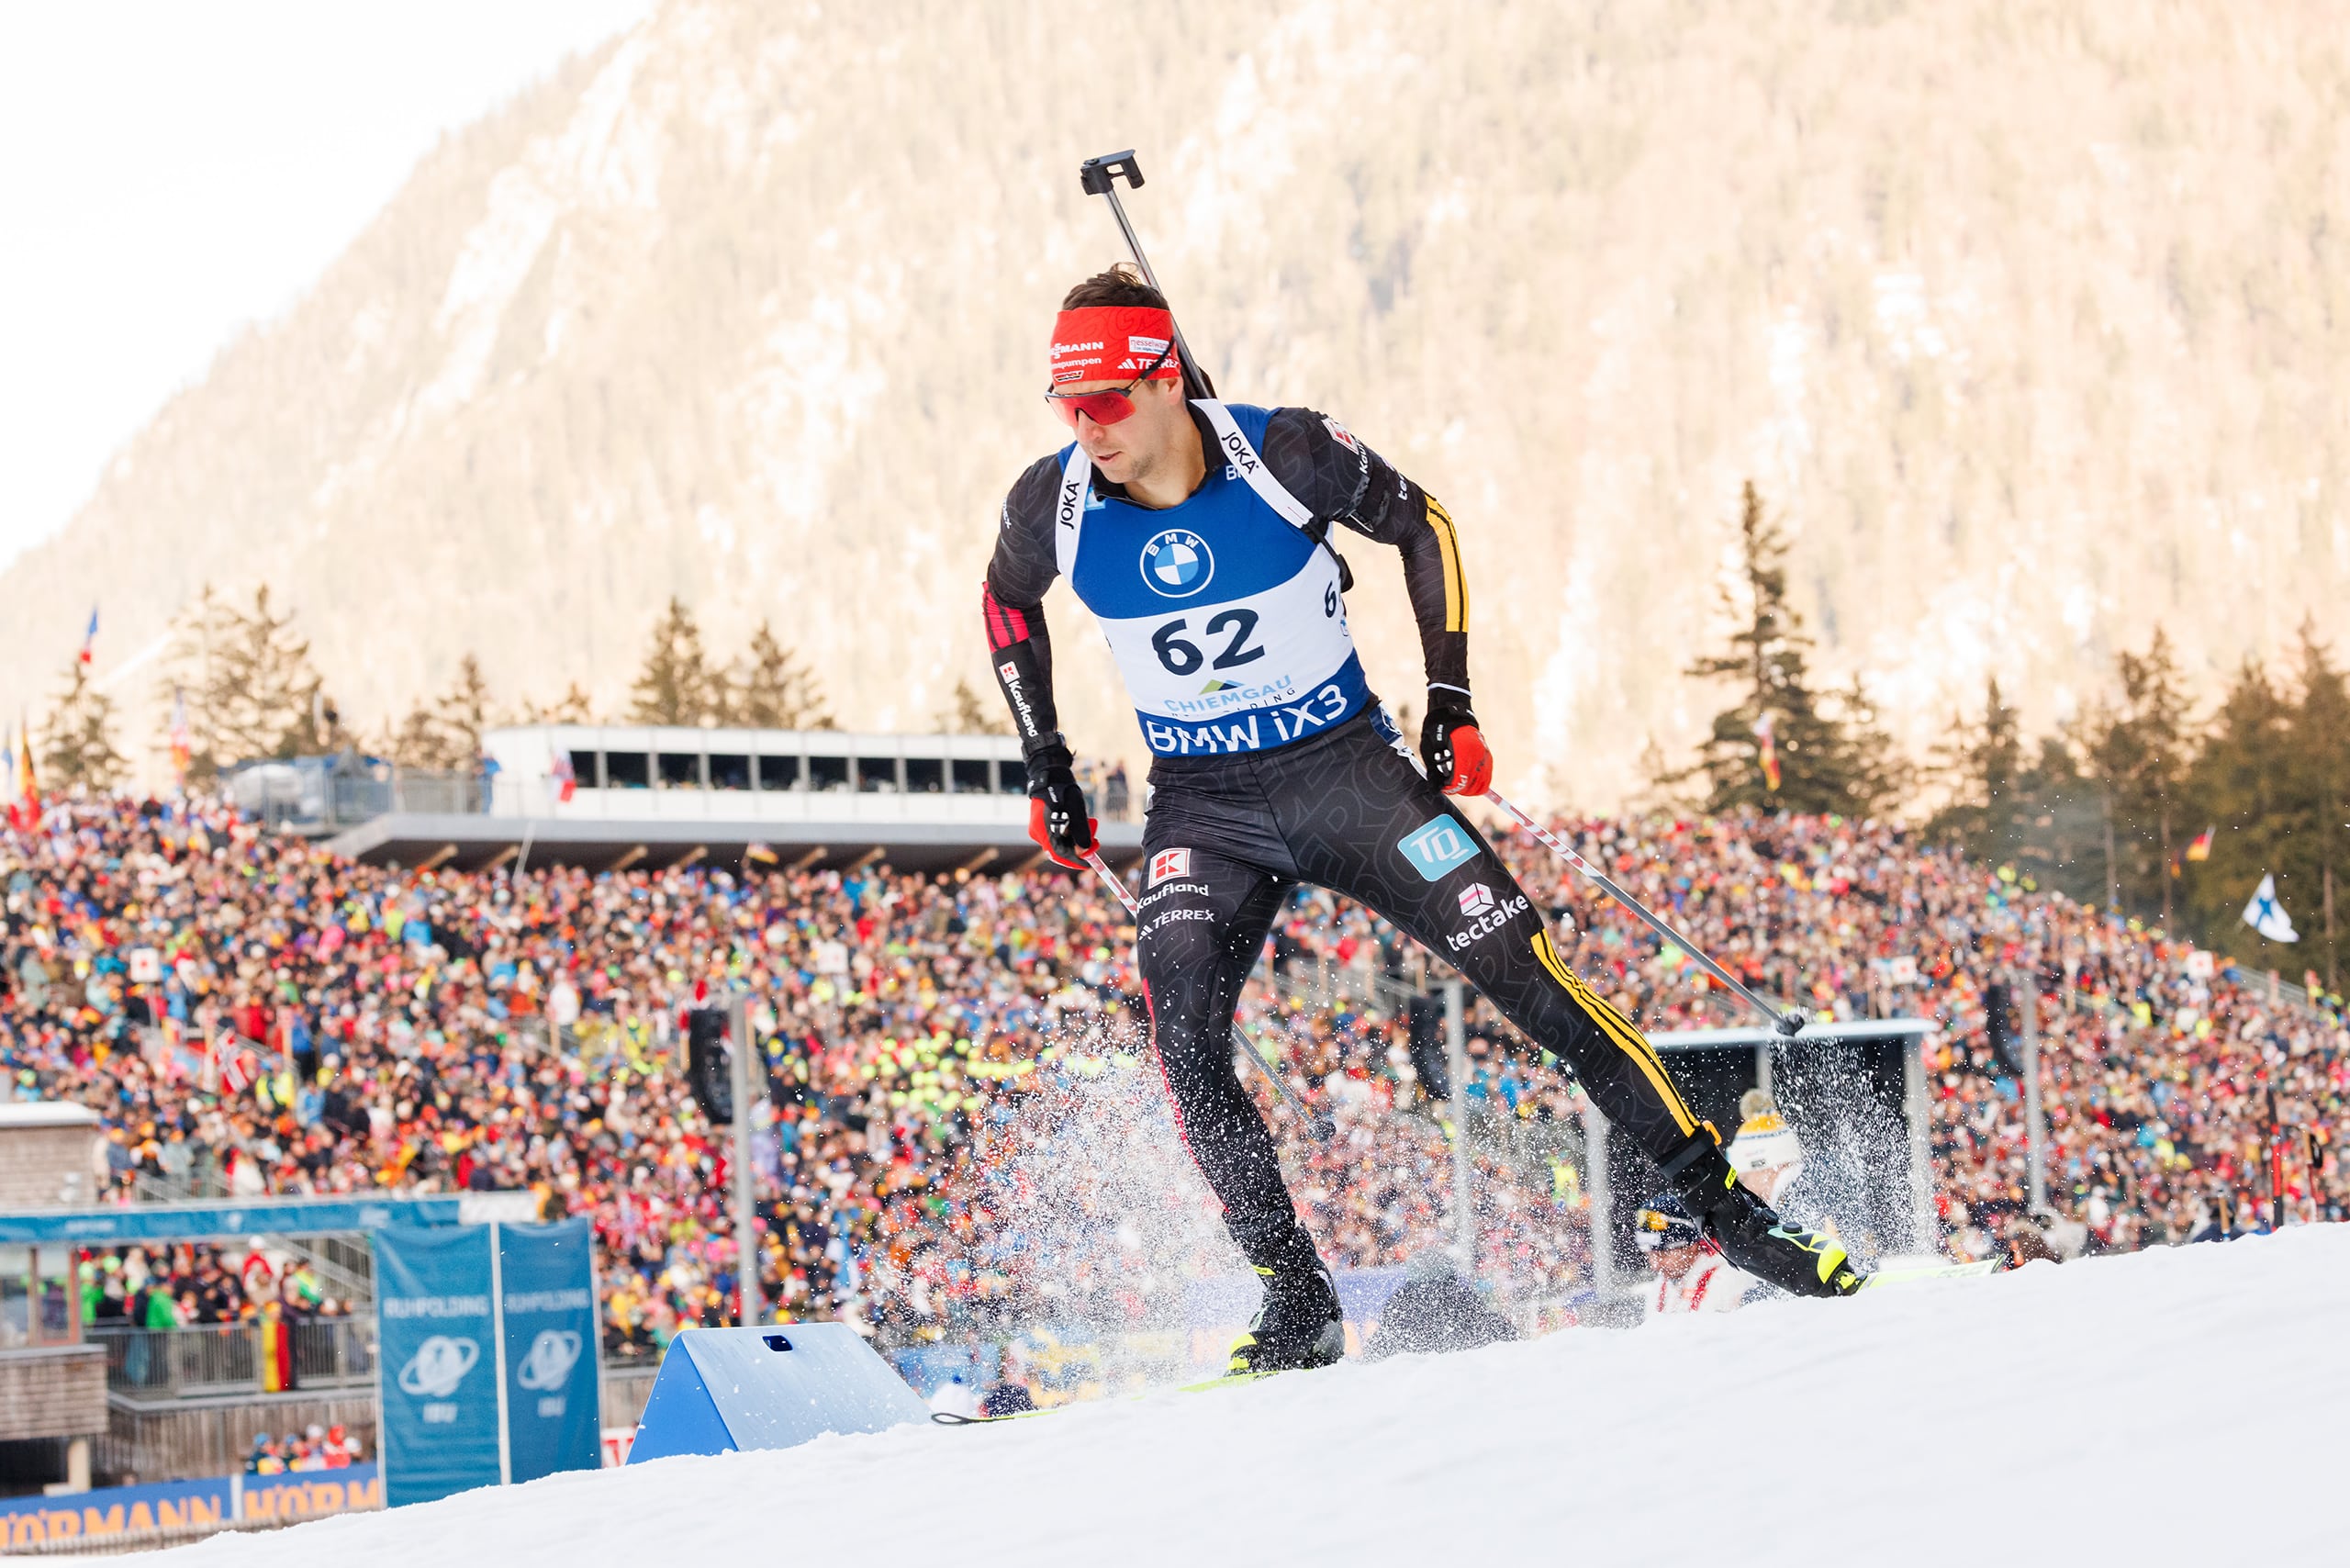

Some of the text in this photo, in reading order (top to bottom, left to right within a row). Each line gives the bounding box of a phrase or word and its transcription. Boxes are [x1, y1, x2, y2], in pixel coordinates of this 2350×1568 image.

[1222, 431, 1257, 475] JOKA
[1060, 482, 1080, 530] JOKA
[1147, 532, 1199, 556] BMW
[1325, 580, 1341, 618] 6
[1151, 608, 1266, 677] 62
[1163, 674, 1292, 713] CHIEMGAU
[1147, 684, 1348, 755] BMW iX3
[1410, 826, 1469, 864] TQ
[1153, 909, 1214, 929] TERREX
[1446, 895, 1529, 952] tectake
